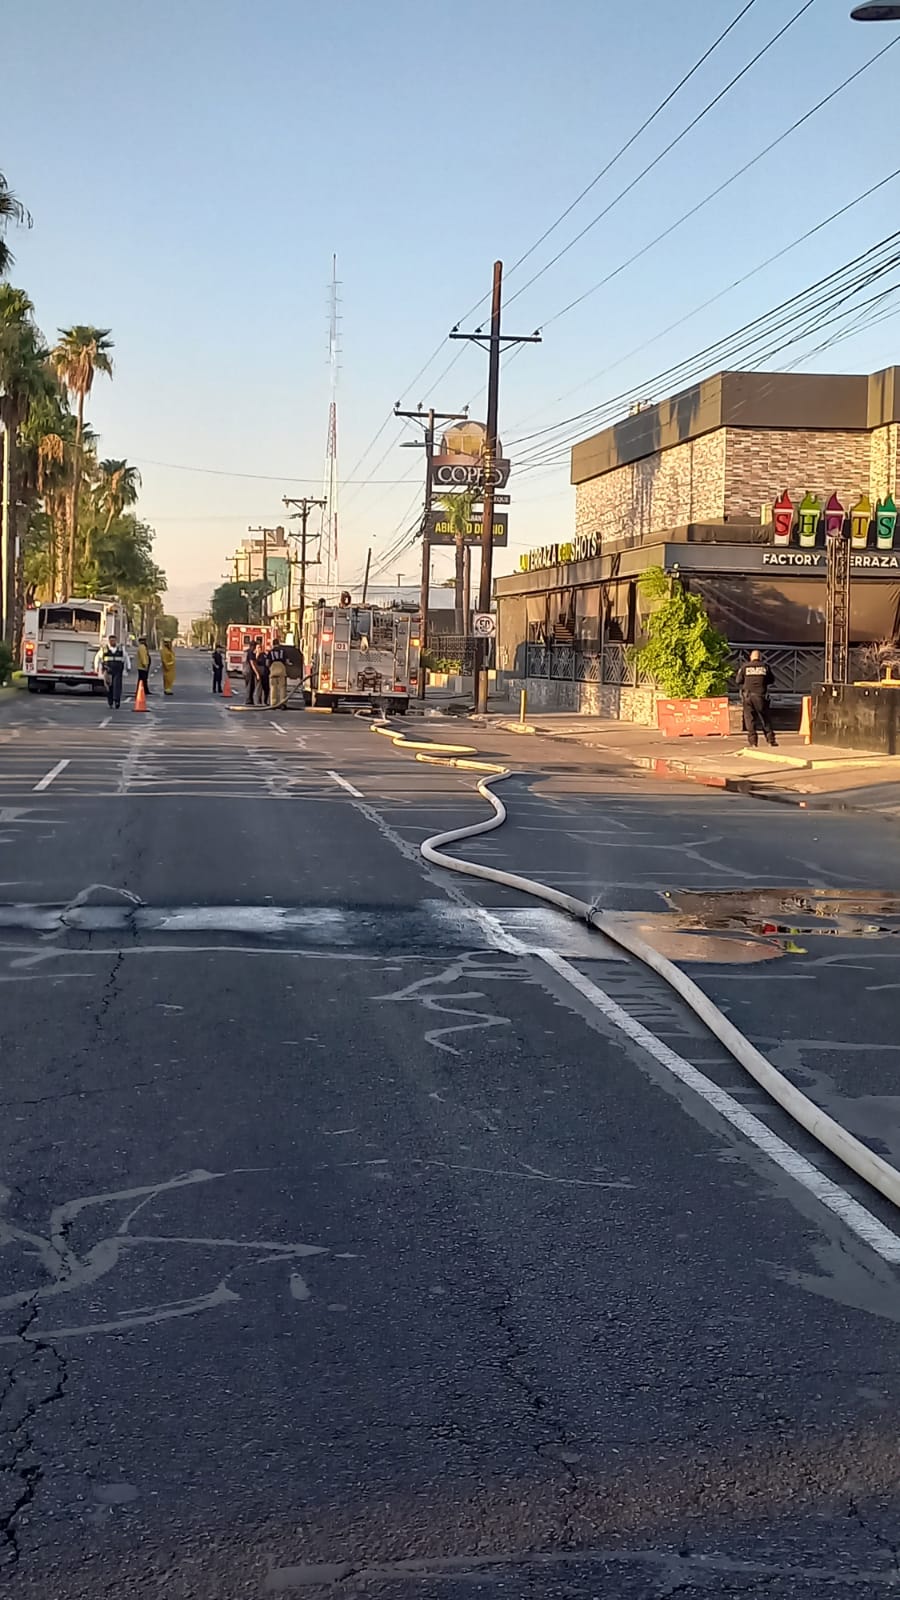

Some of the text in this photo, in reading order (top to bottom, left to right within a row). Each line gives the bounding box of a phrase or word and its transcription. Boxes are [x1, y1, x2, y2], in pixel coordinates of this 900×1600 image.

[435, 522, 504, 535] ABIEO DIIO
[762, 553, 821, 566] FACTORY
[850, 556, 898, 568] ERRAZA
